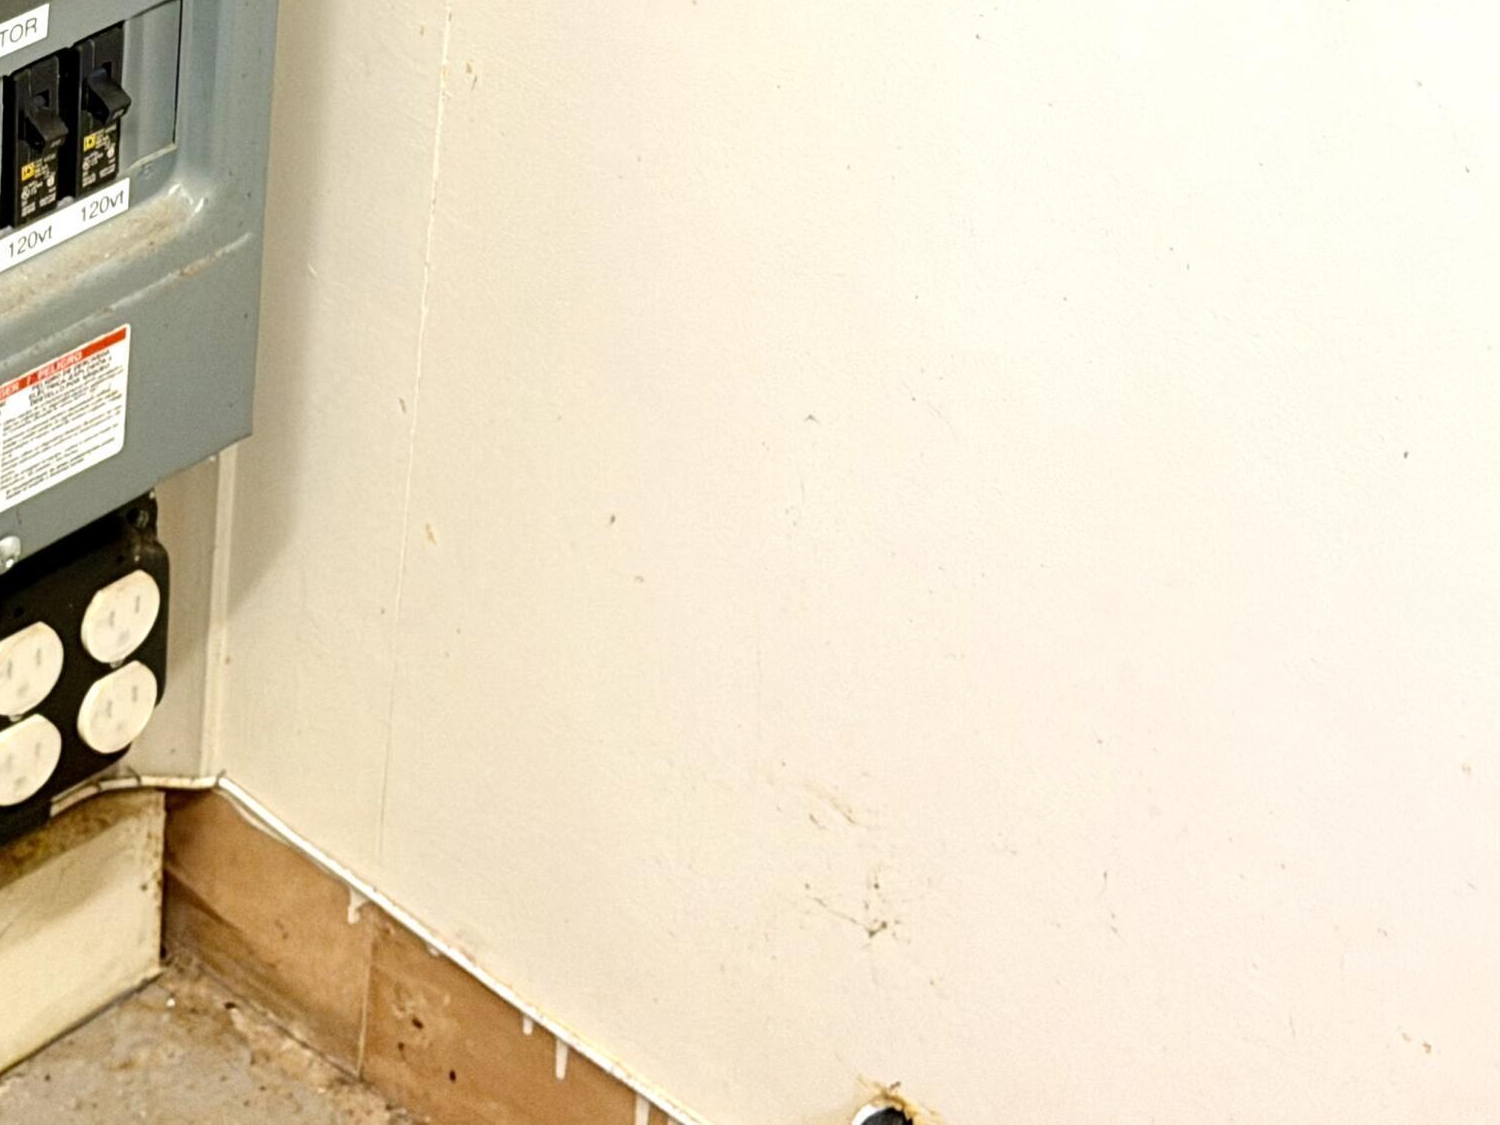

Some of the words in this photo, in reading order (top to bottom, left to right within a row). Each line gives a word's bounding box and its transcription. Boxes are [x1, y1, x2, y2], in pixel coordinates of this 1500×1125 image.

[7, 225, 53, 259] 120vt
[80, 189, 125, 222] 120vt
[37, 350, 83, 380] PELIGRO
